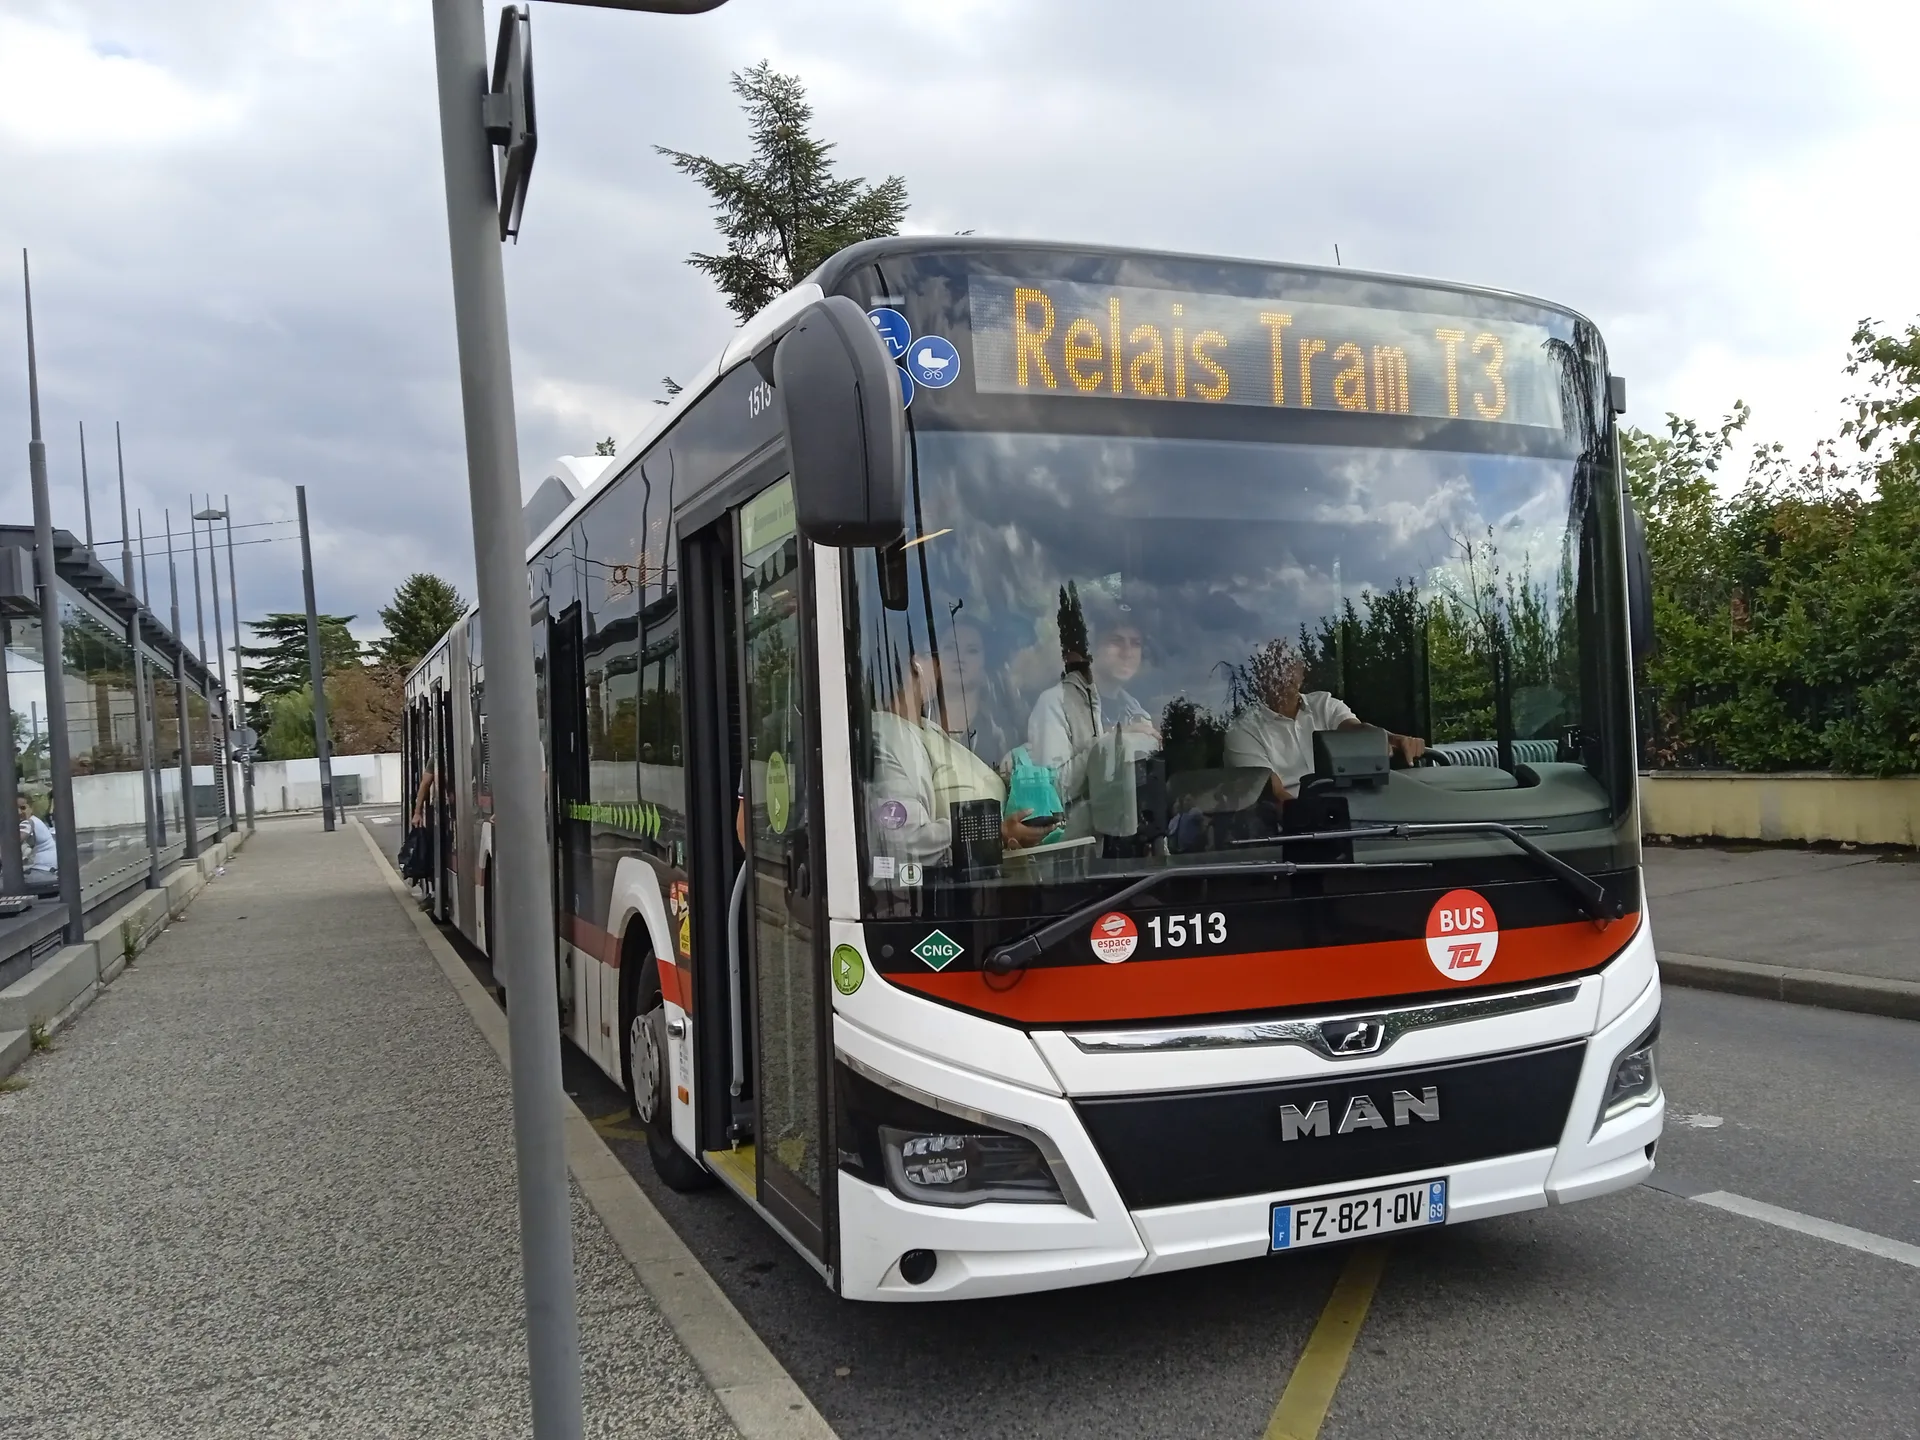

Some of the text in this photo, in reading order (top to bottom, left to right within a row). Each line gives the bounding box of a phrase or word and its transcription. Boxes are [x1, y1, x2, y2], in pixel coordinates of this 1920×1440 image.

[1014, 287, 1507, 419] Relais Tram T3
[748, 381, 772, 419] 1513
[1147, 911, 1228, 948] 1513
[1439, 906, 1486, 934] BUS
[921, 943, 953, 958] CNG
[1097, 938, 1132, 949] espace
[1447, 942, 1483, 970] TCL
[1279, 1086, 1440, 1142] MAN
[1278, 1190, 1444, 1242] F FZ-821-QV 69
